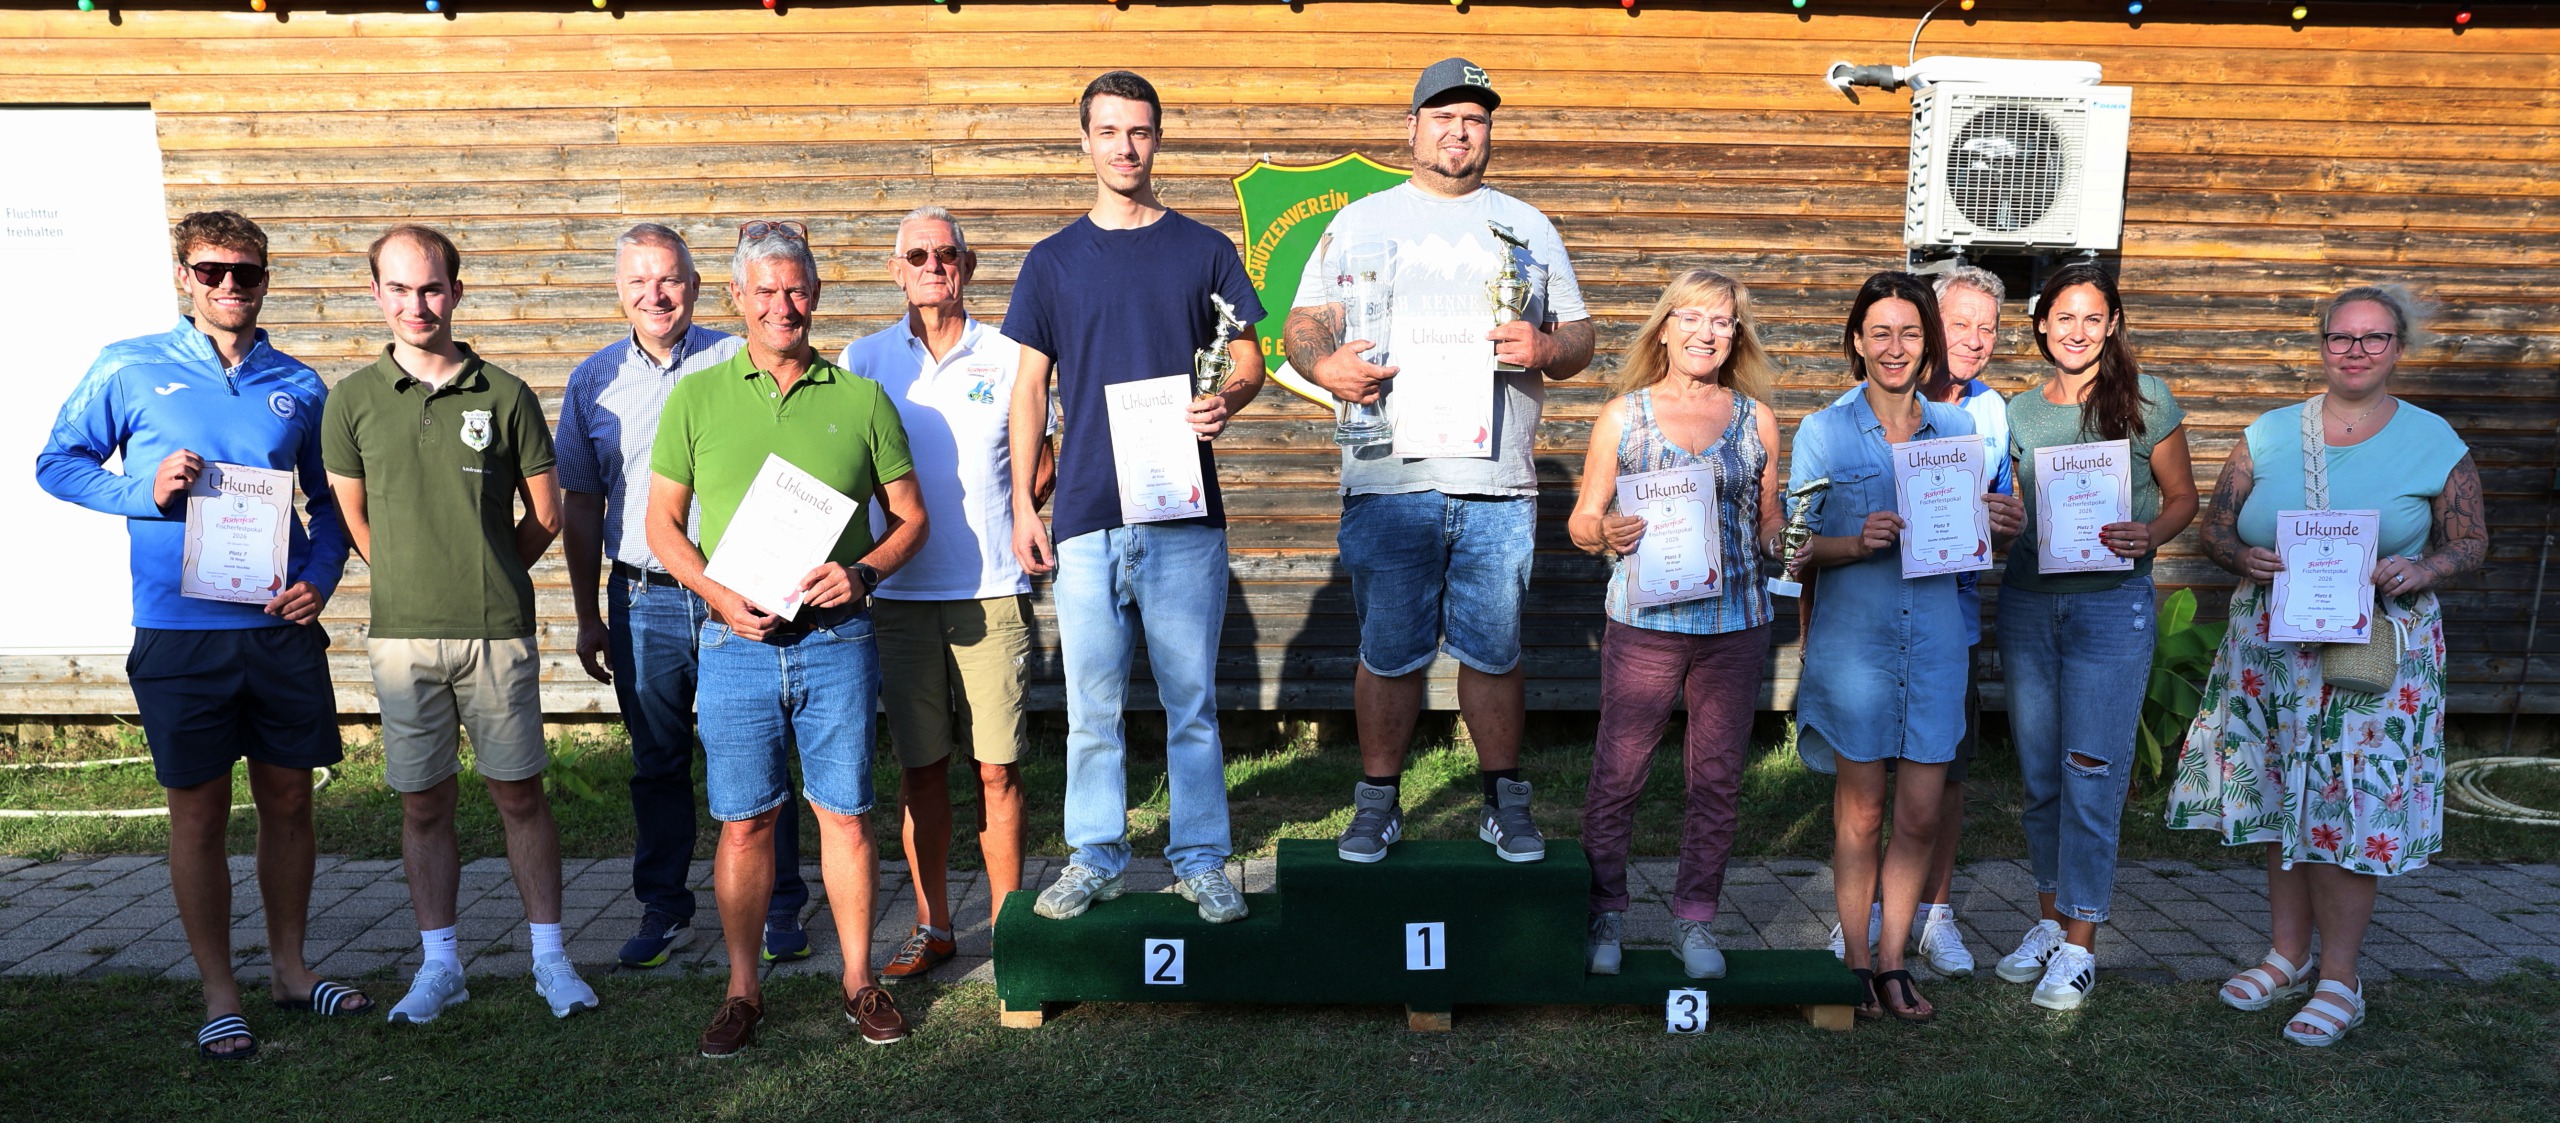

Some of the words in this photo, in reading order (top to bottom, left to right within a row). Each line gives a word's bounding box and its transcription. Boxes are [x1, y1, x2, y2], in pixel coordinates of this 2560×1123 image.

[1262, 336, 1285, 356] GE
[1412, 328, 1474, 344] Urkunde
[1122, 389, 1174, 411] Urkunde
[1984, 436, 1997, 448] st
[1908, 448, 1967, 468] Urkunde
[2053, 453, 2113, 472] Urkunde
[209, 473, 274, 495] Urkunde
[776, 472, 832, 515] Urkunde
[1636, 478, 1697, 500] Urkunde
[1920, 496, 1961, 506] Fischerfestpokal
[2063, 500, 2106, 508] Fischerfestpokal
[216, 523, 262, 533] Fischerfestpokal
[1649, 527, 1692, 538] Fischerfestpokal
[2296, 521, 2359, 536] Urkunde
[1418, 927, 1431, 966] 1
[1153, 944, 1176, 981] 2
[1675, 994, 1698, 1032] 3
